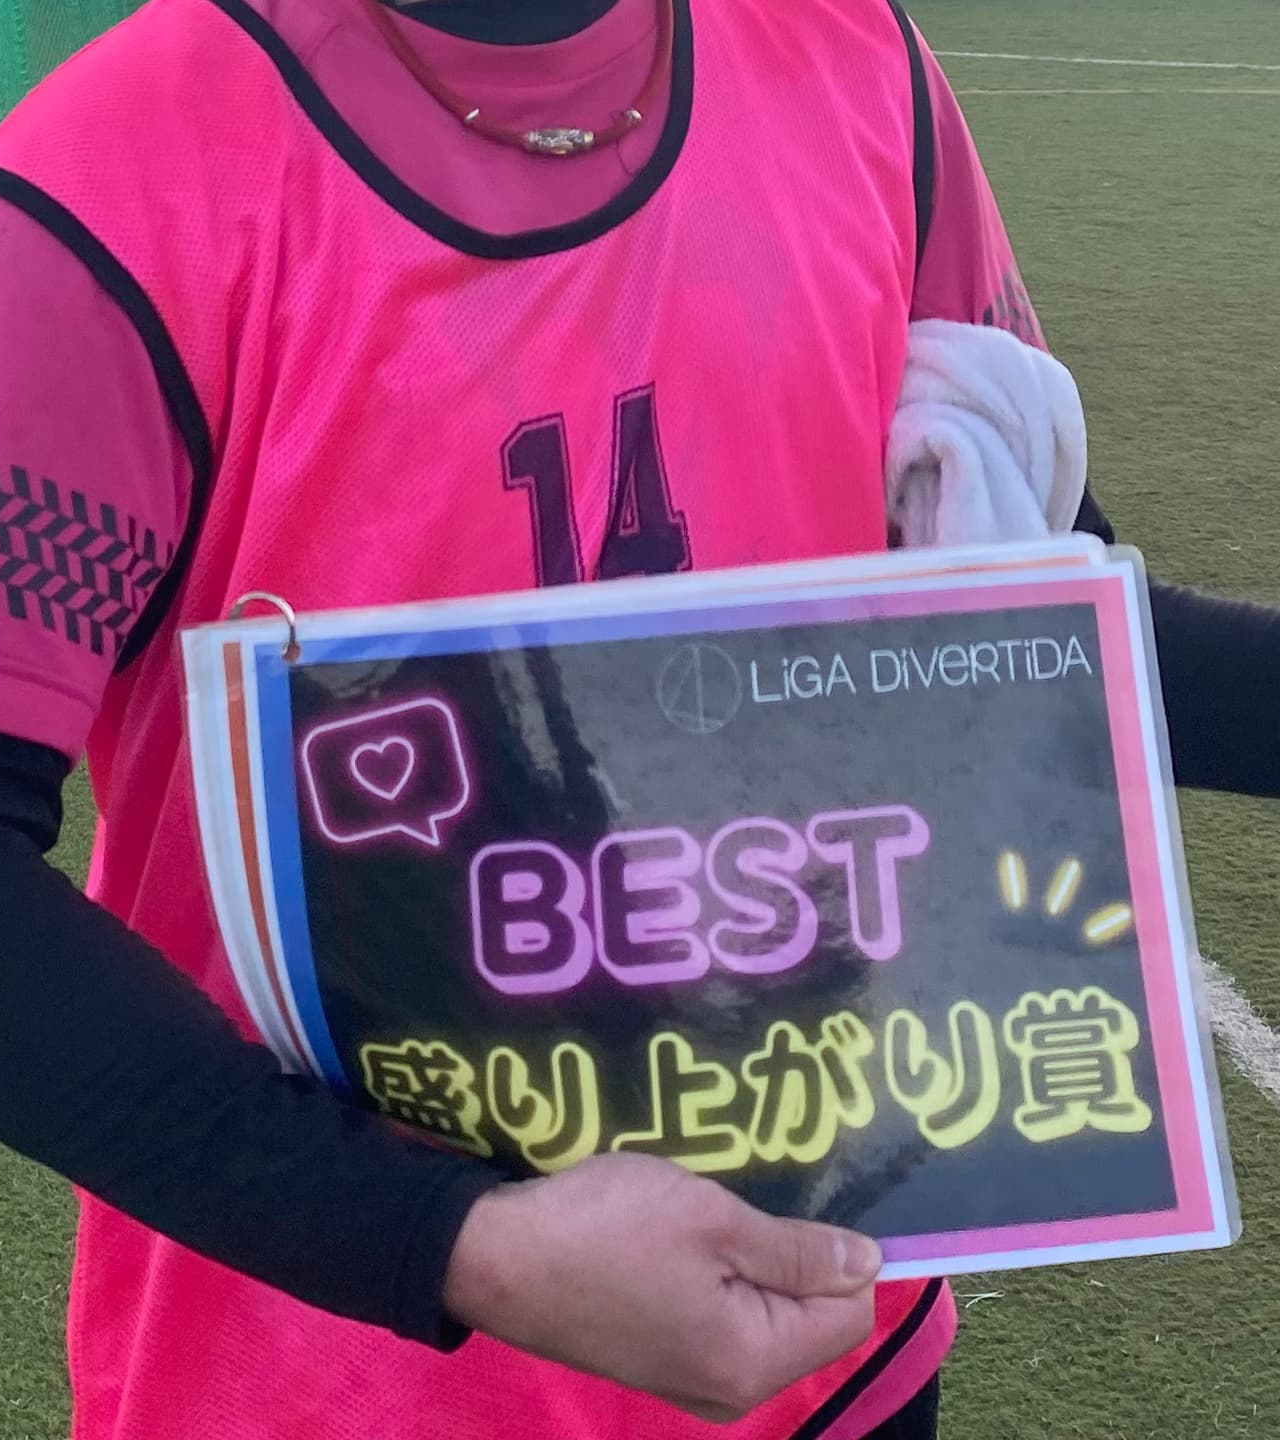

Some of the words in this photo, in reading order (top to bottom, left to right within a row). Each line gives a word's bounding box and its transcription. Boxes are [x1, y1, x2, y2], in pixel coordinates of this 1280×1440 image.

[500, 380, 693, 587] 14
[469, 804, 931, 995] BEST
[360, 986, 1153, 1173] 盛り上がり賞
